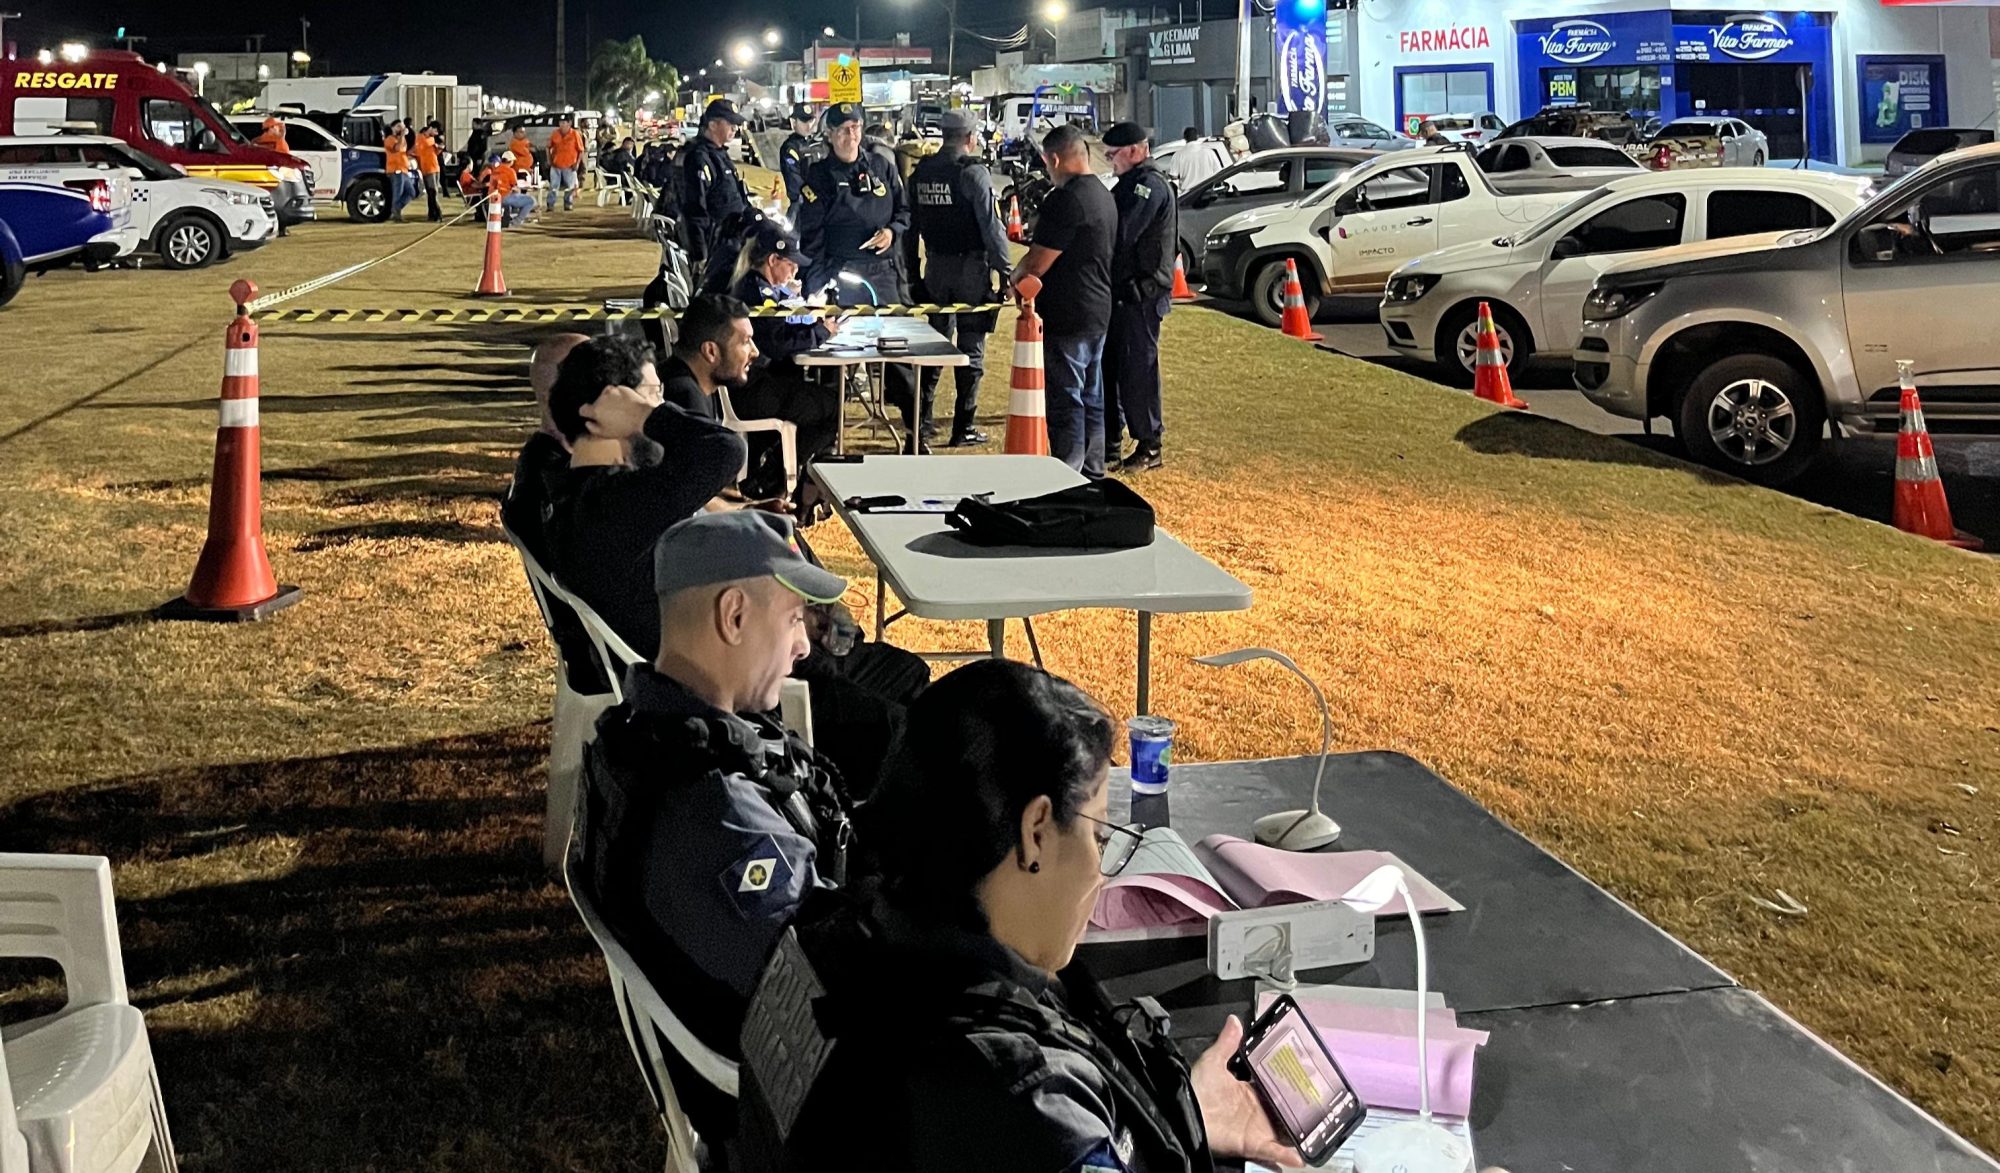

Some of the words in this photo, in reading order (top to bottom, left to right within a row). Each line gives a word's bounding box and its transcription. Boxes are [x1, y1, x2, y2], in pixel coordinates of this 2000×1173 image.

[1400, 22, 1490, 52] FARMÁCIA
[1538, 35, 1565, 55] Vita
[1565, 37, 1612, 55] Farma
[1708, 28, 1739, 48] Vita
[1739, 32, 1788, 50] Farma
[1171, 42, 1192, 56] LIMA
[14, 72, 119, 90] RESGATE
[1899, 70, 1930, 86] DISK
[1550, 80, 1577, 97] PBM
[1355, 222, 1407, 236] LAVORO
[1359, 247, 1396, 257] IMPACTO
